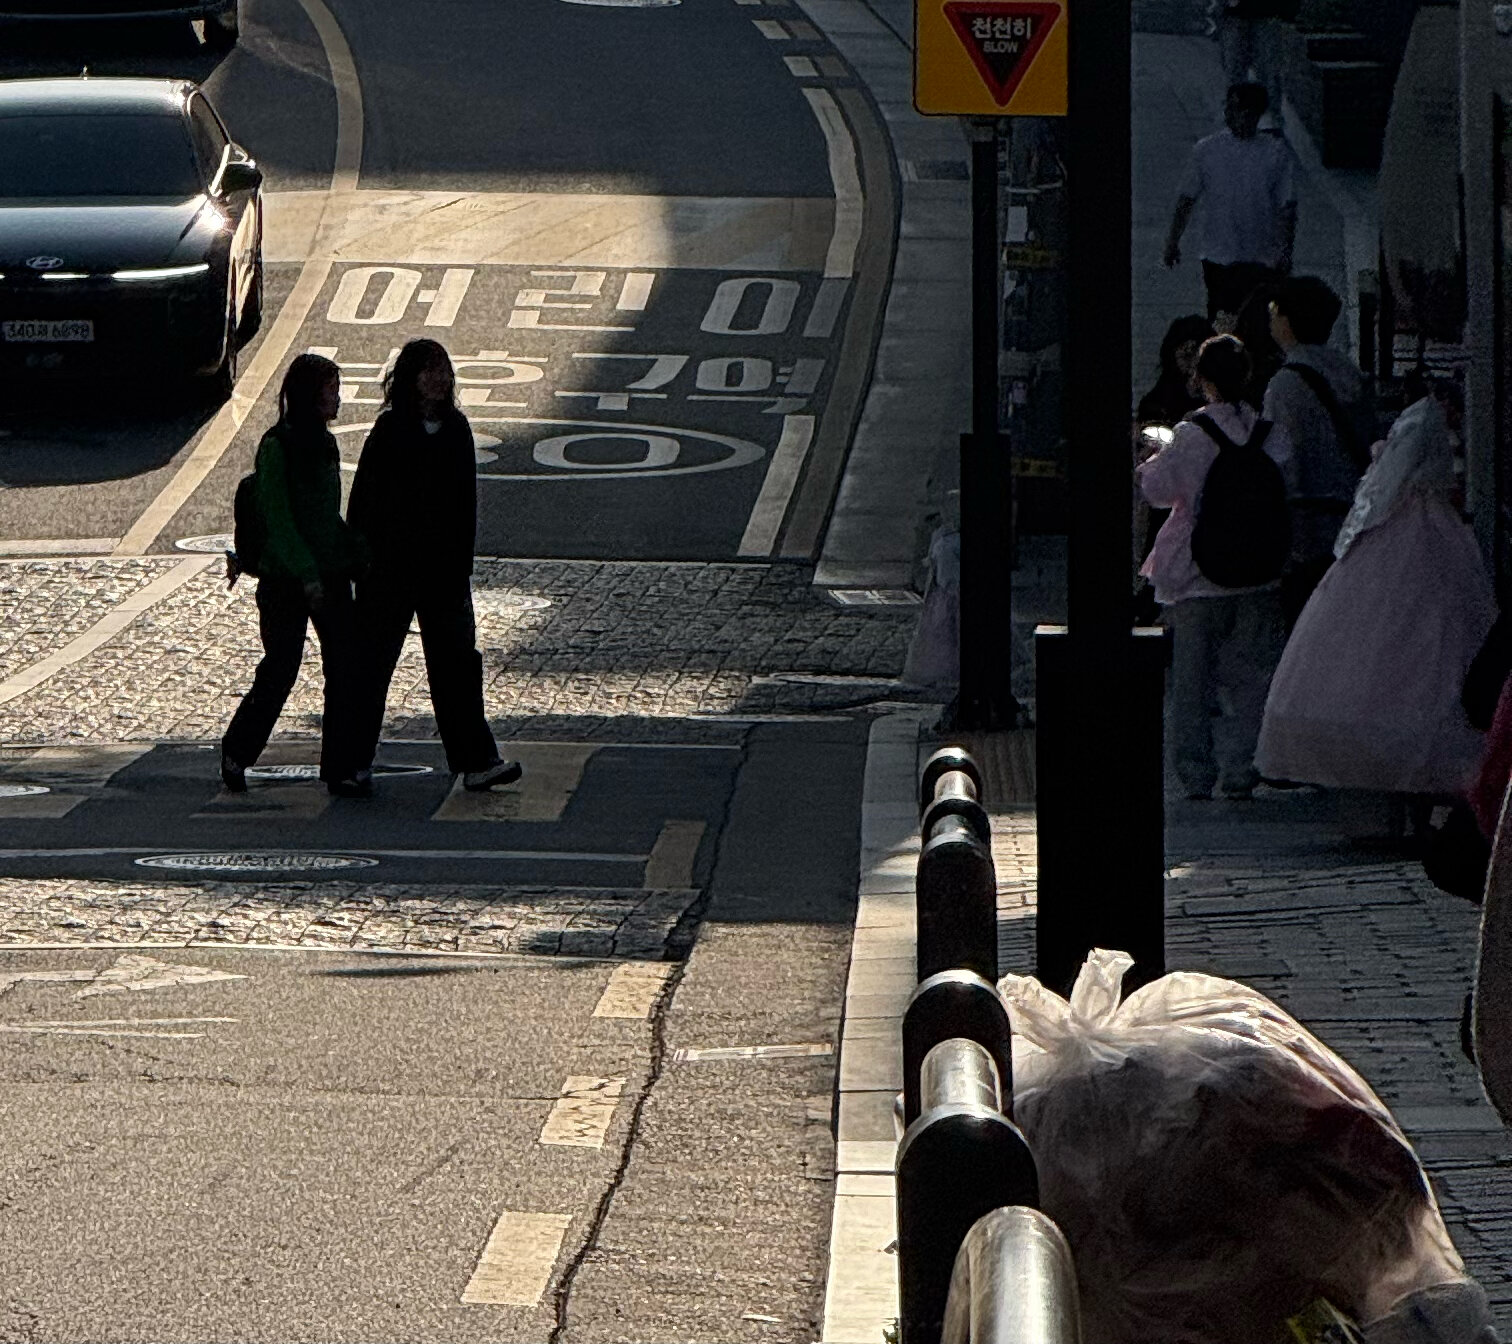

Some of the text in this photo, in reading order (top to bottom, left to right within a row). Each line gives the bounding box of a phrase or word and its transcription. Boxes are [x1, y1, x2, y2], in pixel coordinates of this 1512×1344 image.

[971, 16, 1032, 40] 천천히
[982, 40, 1019, 54] SLOW
[325, 266, 852, 340] 어린이
